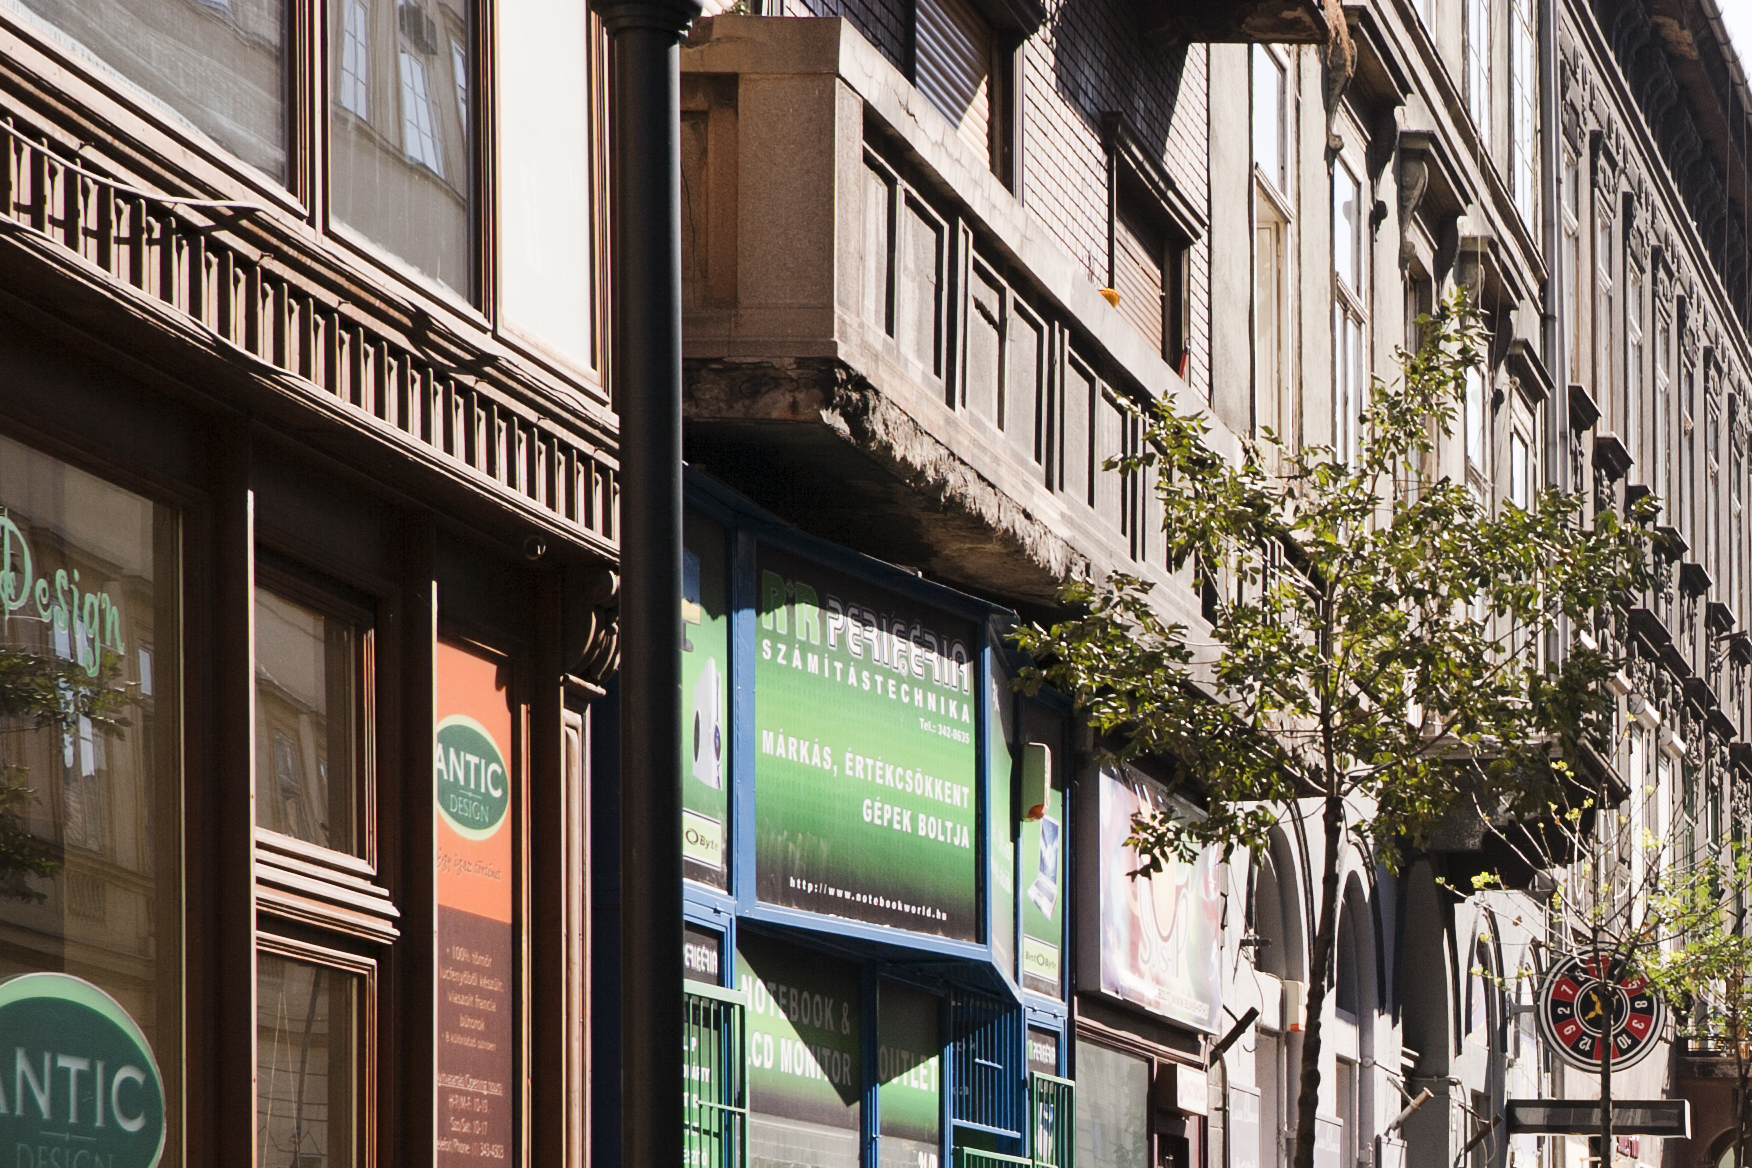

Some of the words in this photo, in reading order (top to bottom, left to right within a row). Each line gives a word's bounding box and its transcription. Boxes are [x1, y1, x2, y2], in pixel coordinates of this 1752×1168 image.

[826, 594, 971, 695] PERIFÉRIA
[762, 638, 970, 723] SZÁMÍTÁSTECHNIKA
[919, 717, 936, 734] Tel.:
[938, 724, 970, 745] 342-0635
[437, 743, 503, 798] ANTIC
[762, 728, 838, 777] MÁRKÁS,
[845, 747, 970, 809] ÉRTÉKCSÖKKENT
[450, 794, 489, 823] DESIGN
[863, 796, 912, 833] GÉPEK
[918, 813, 970, 849] BOLTJA
[790, 876, 947, 921] http://www.notebookworld.hu
[741, 974, 834, 1031] NOTEBOOK
[842, 1002, 849, 1034] &
[748, 1031, 774, 1069] CD
[780, 1037, 851, 1086] MONITOR
[878, 1044, 937, 1092] OUTLET
